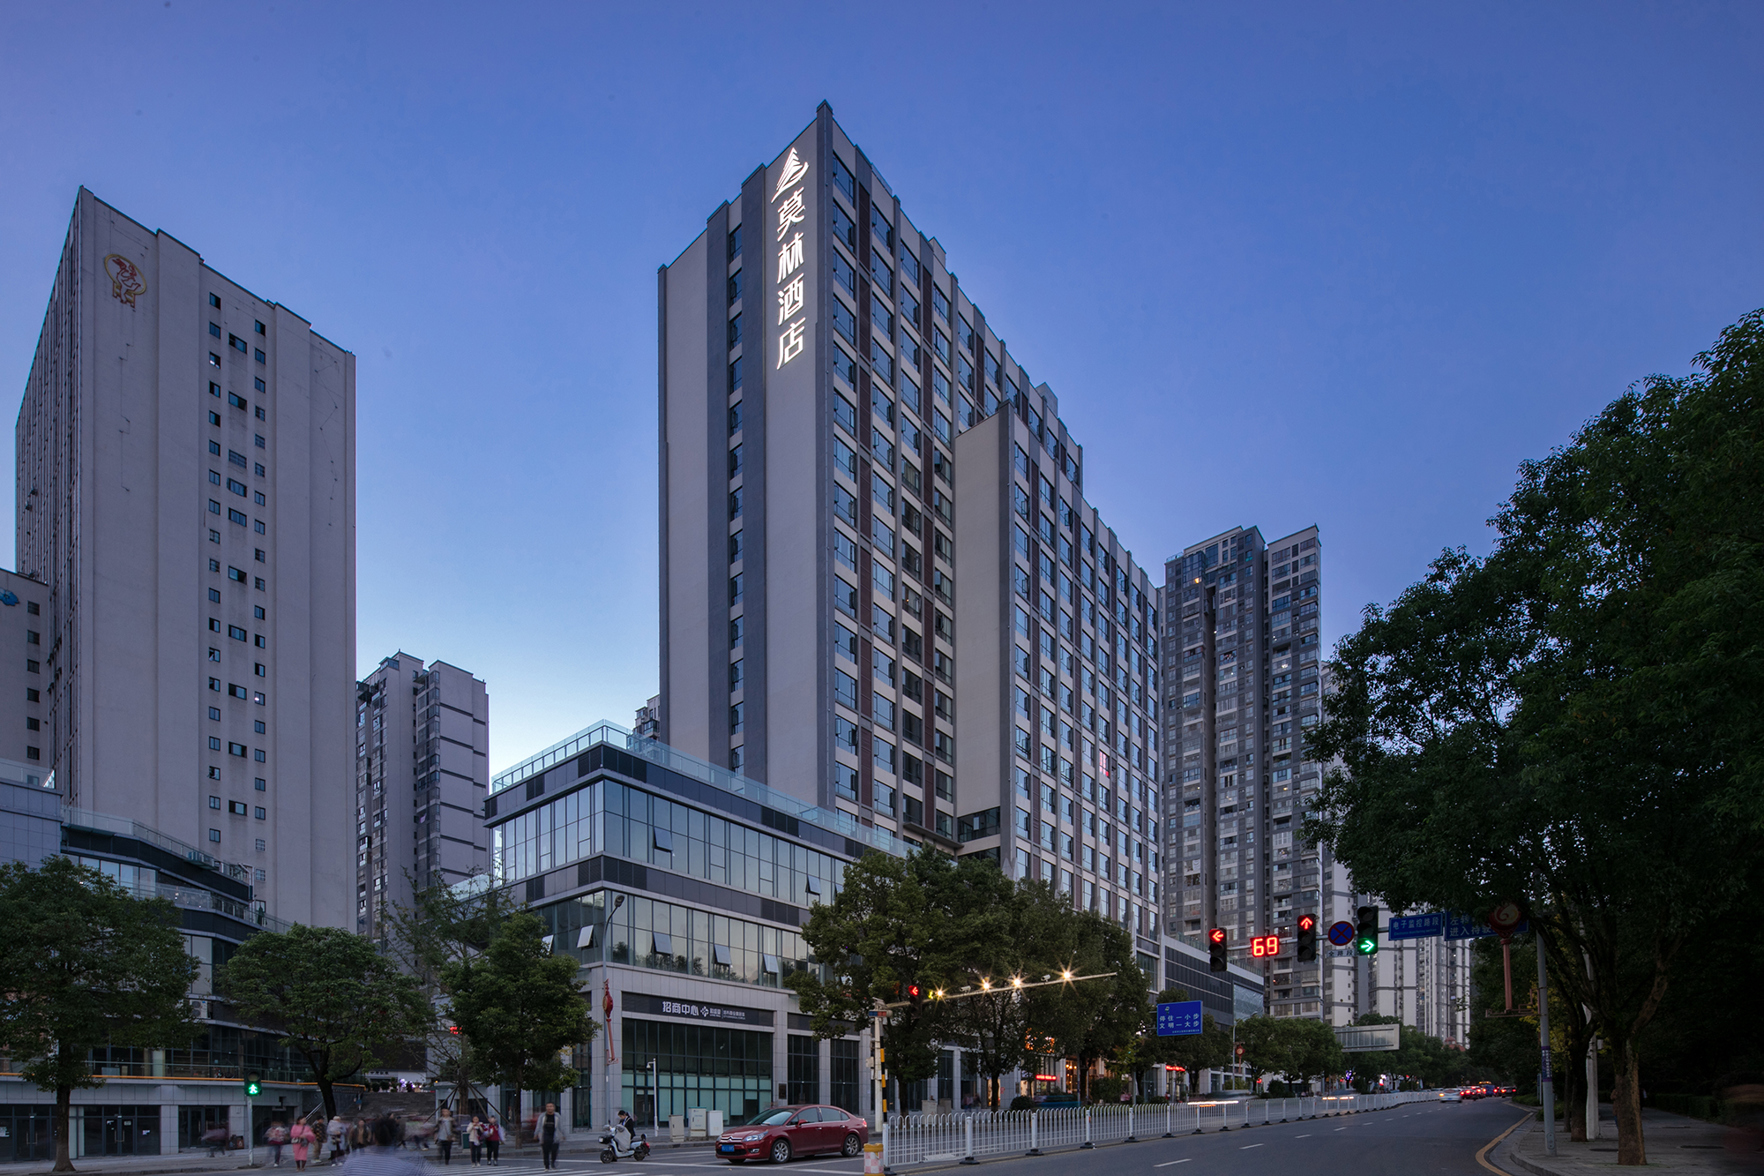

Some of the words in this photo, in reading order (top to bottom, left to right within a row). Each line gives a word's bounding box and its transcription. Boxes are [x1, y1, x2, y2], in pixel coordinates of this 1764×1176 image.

[777, 187, 806, 370] 莫林酒店
[1392, 916, 1439, 930] 电子监控路段
[662, 1001, 699, 1016] 招商中心
[1159, 1013, 1200, 1022] 停住一小步
[1159, 1020, 1200, 1029] 文明一大步
